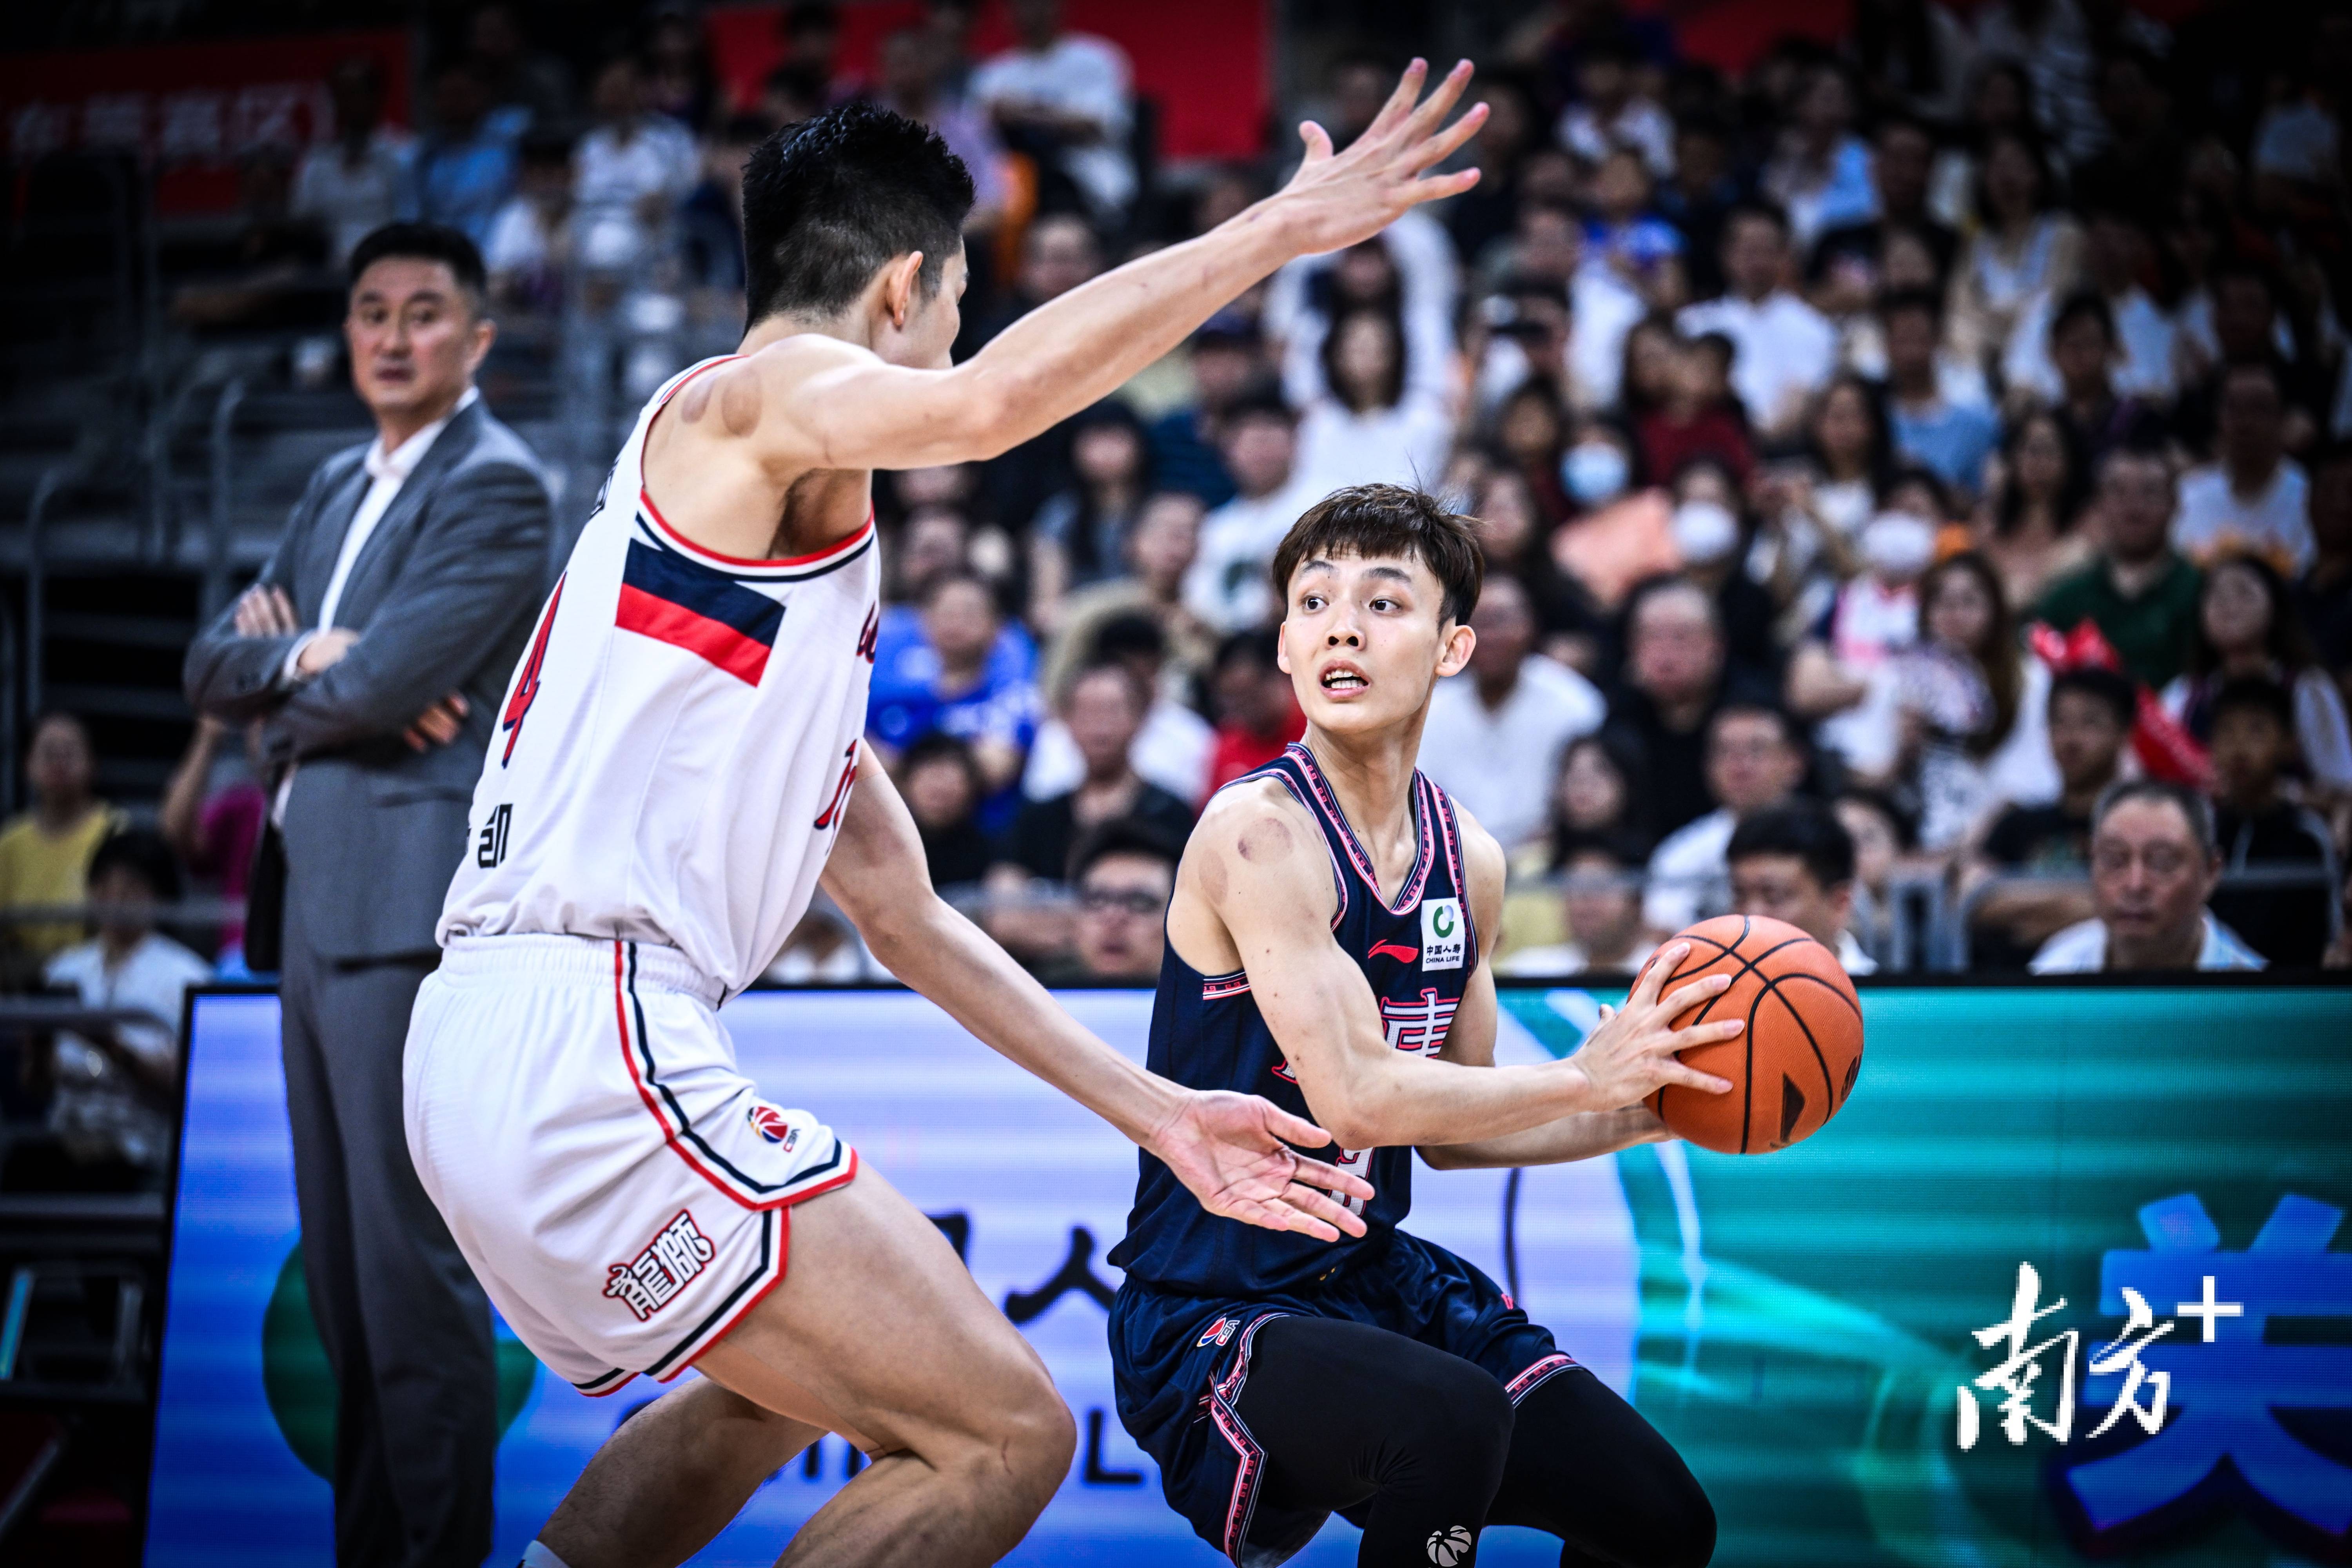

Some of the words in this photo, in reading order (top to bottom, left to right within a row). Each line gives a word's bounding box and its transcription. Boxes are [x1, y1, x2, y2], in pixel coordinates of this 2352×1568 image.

[1427, 944, 1461, 956] 中国人寿
[1216, 1320, 1240, 1346] CBA
